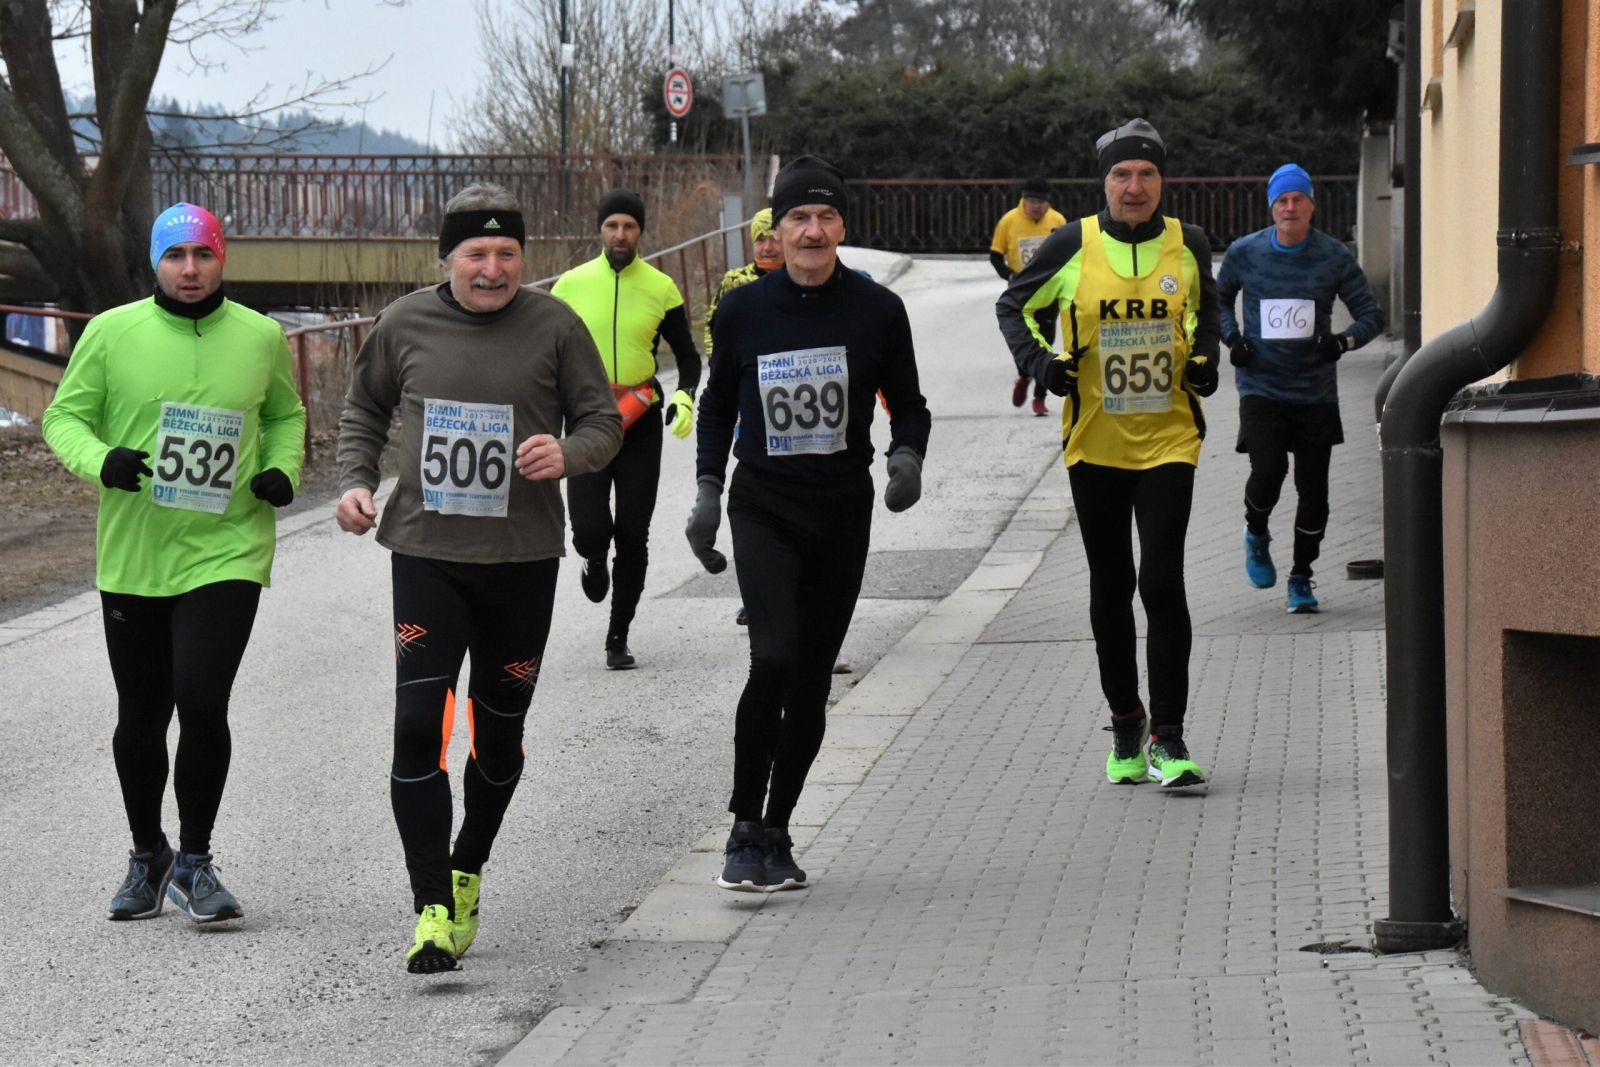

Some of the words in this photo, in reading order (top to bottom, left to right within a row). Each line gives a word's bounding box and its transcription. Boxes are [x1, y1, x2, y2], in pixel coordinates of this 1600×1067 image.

[1100, 298, 1168, 320] KRB
[1268, 305, 1307, 329] 616
[1101, 327, 1132, 337] ZIMNÍ
[1101, 336, 1146, 348] BĚŽECKÁ
[1150, 334, 1172, 345] LIGA
[761, 355, 795, 370] ZIMNÍ
[761, 365, 811, 381] BĚŽECKÁ
[816, 364, 843, 376] LIGA
[1105, 350, 1172, 395] 653
[165, 407, 200, 420] ZIMNÍ
[428, 404, 462, 418] ZIMNÍ
[766, 381, 845, 432] 639
[162, 419, 213, 434] BĚŽECKÁ
[218, 426, 239, 438] LIGA
[426, 416, 476, 432] BĚŽECKÁ
[482, 423, 509, 433] LIGA
[157, 435, 235, 490] 532
[423, 435, 507, 490] 506
